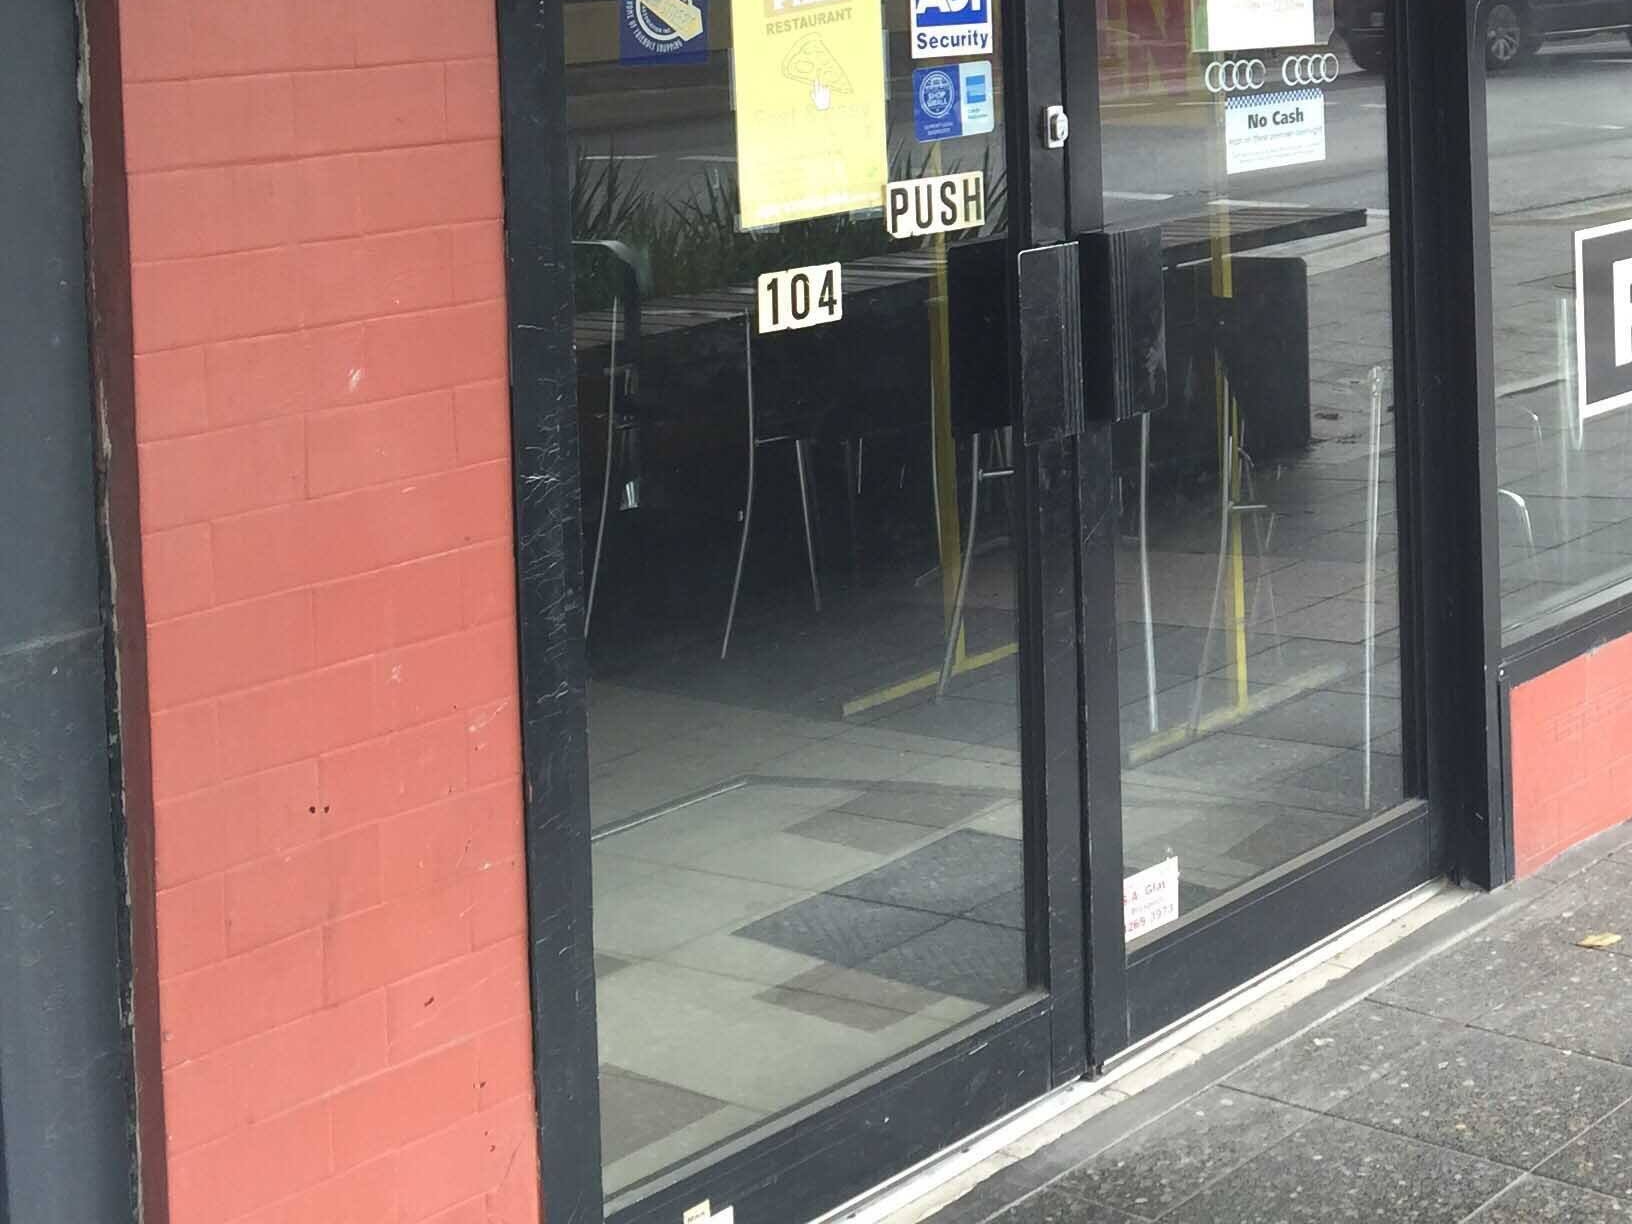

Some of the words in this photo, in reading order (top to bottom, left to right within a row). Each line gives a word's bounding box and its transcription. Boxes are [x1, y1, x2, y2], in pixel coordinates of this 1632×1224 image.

[766, 7, 853, 36] RESTAURANT
[917, 29, 989, 50] Security
[1247, 114, 1268, 129] No
[1272, 107, 1304, 125] Cash
[890, 177, 981, 233] PUSH
[766, 269, 837, 325] 104
